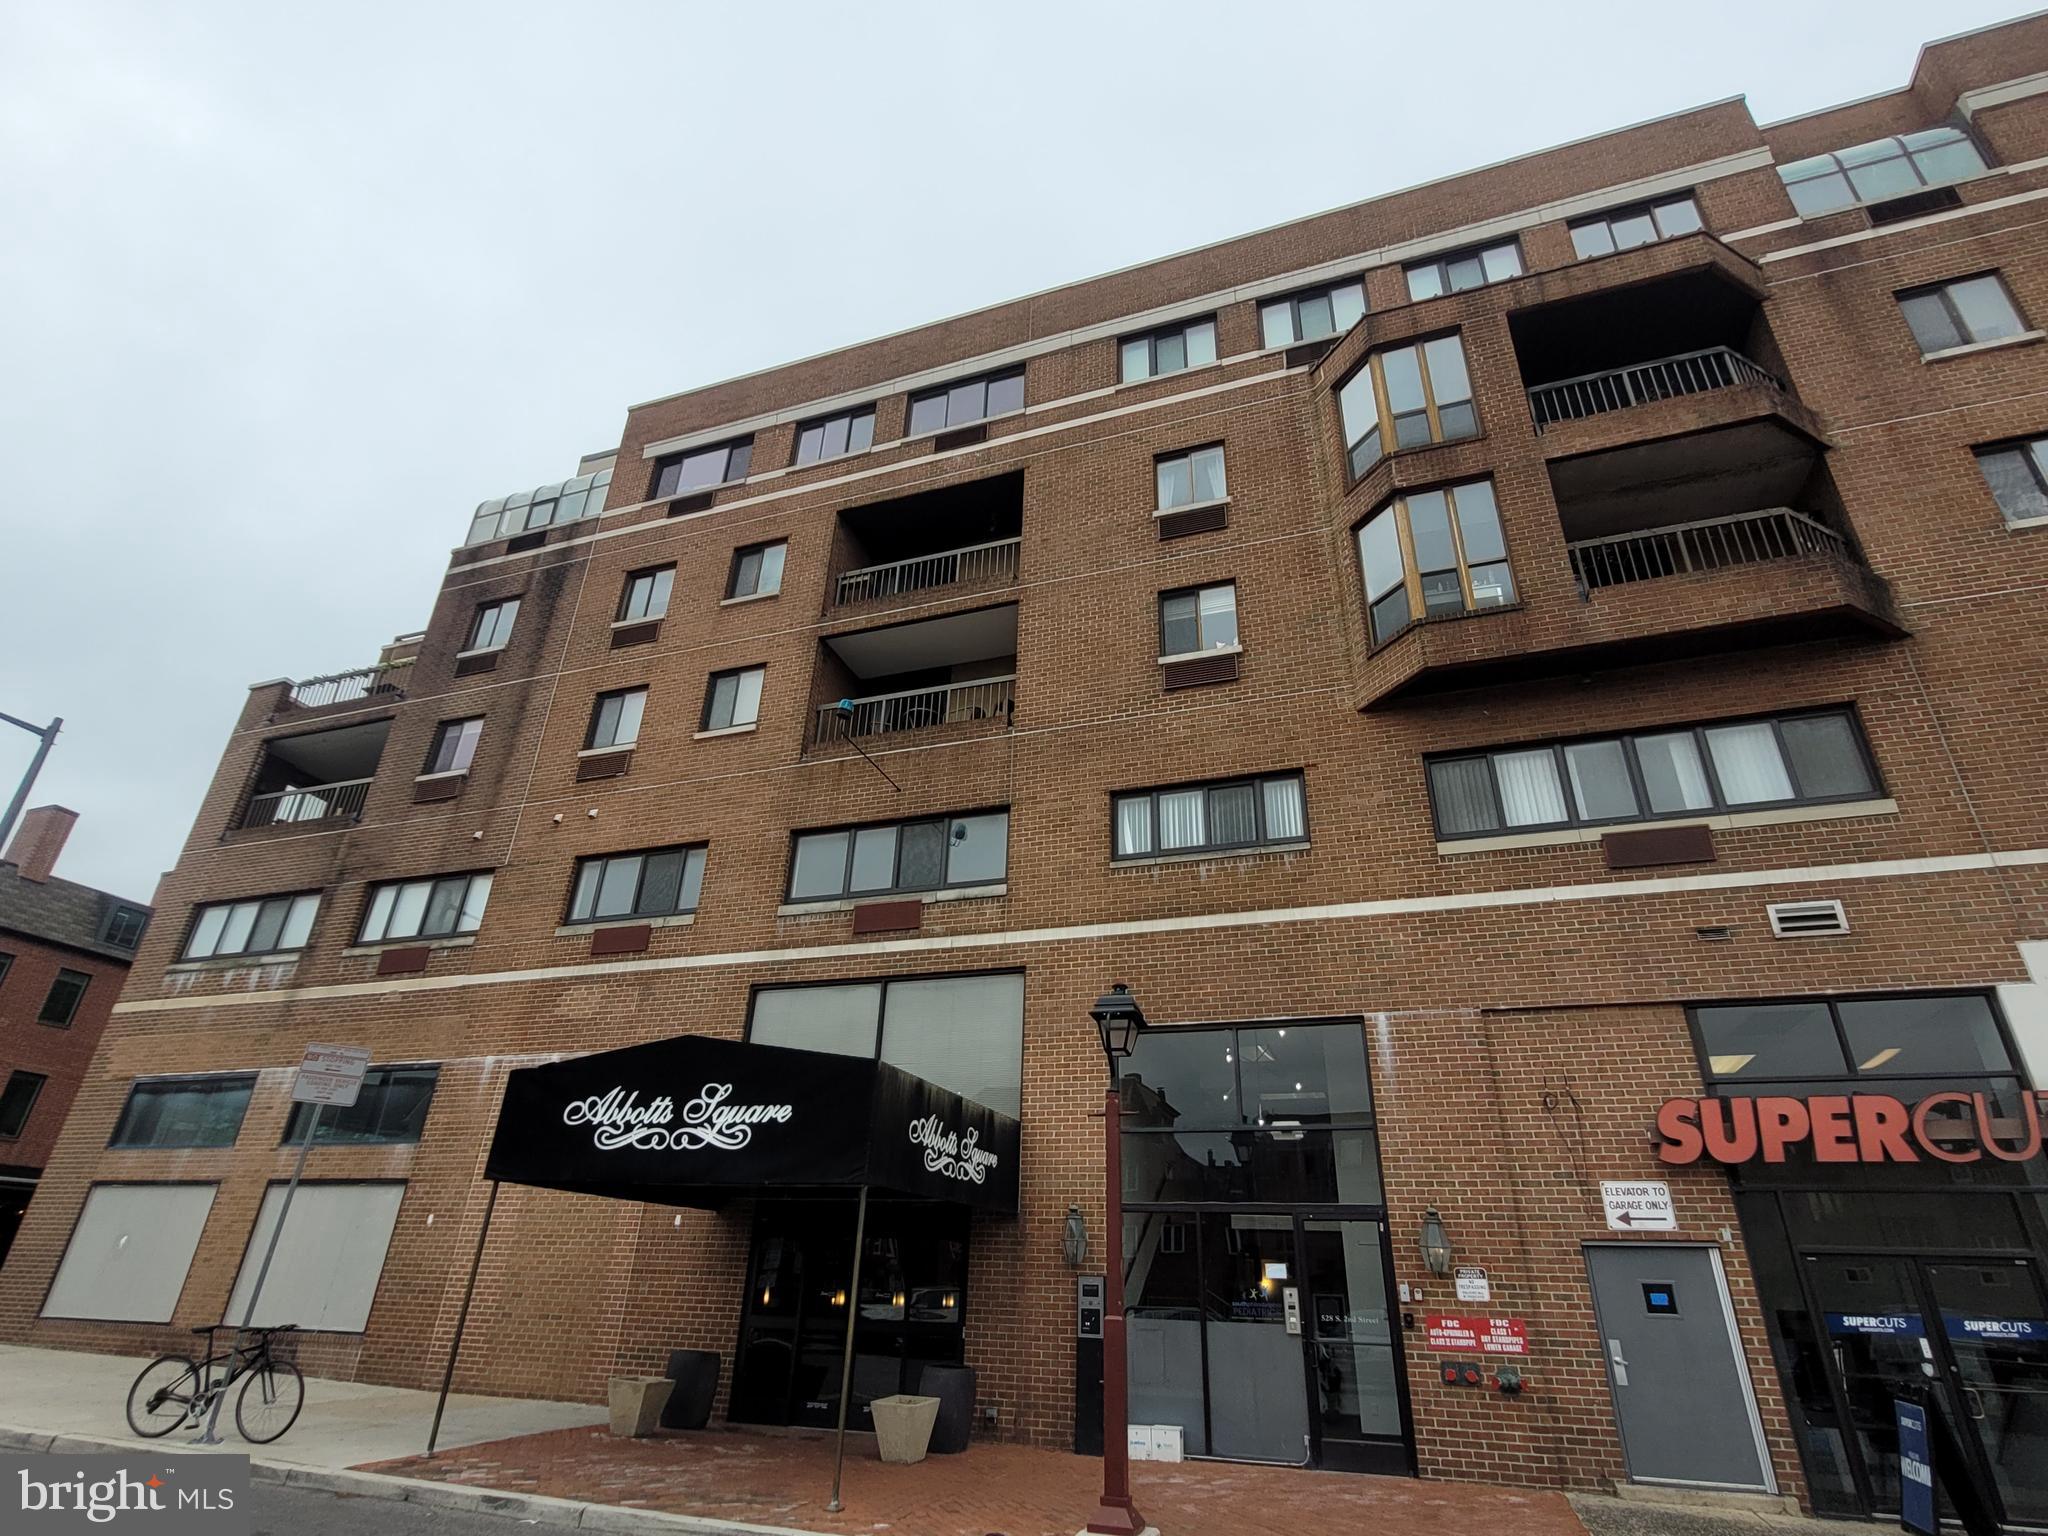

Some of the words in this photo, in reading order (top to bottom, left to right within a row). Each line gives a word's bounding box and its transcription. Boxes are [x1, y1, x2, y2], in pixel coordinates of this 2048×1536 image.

[321, 1056, 354, 1065] STOPPING
[563, 1085, 674, 1142] Abbotts
[683, 1083, 793, 1142] Square
[1656, 1090, 2048, 1165] SUPERCU
[909, 1113, 958, 1168] Abbotts
[961, 1126, 998, 1174] Square
[1604, 1187, 1649, 1197] ELEVATOR
[1652, 1187, 1666, 1196] TO
[1608, 1200, 1643, 1210] GARAGE
[1645, 1200, 1669, 1210] ONLY
[1441, 1319, 1460, 1328] FDC
[1489, 1319, 1510, 1327] FDC
[1843, 1316, 1907, 1328] SUPERCUTS
[1963, 1320, 2032, 1333] SUPERCUTS
[1490, 1328, 1507, 1336] CLASS
